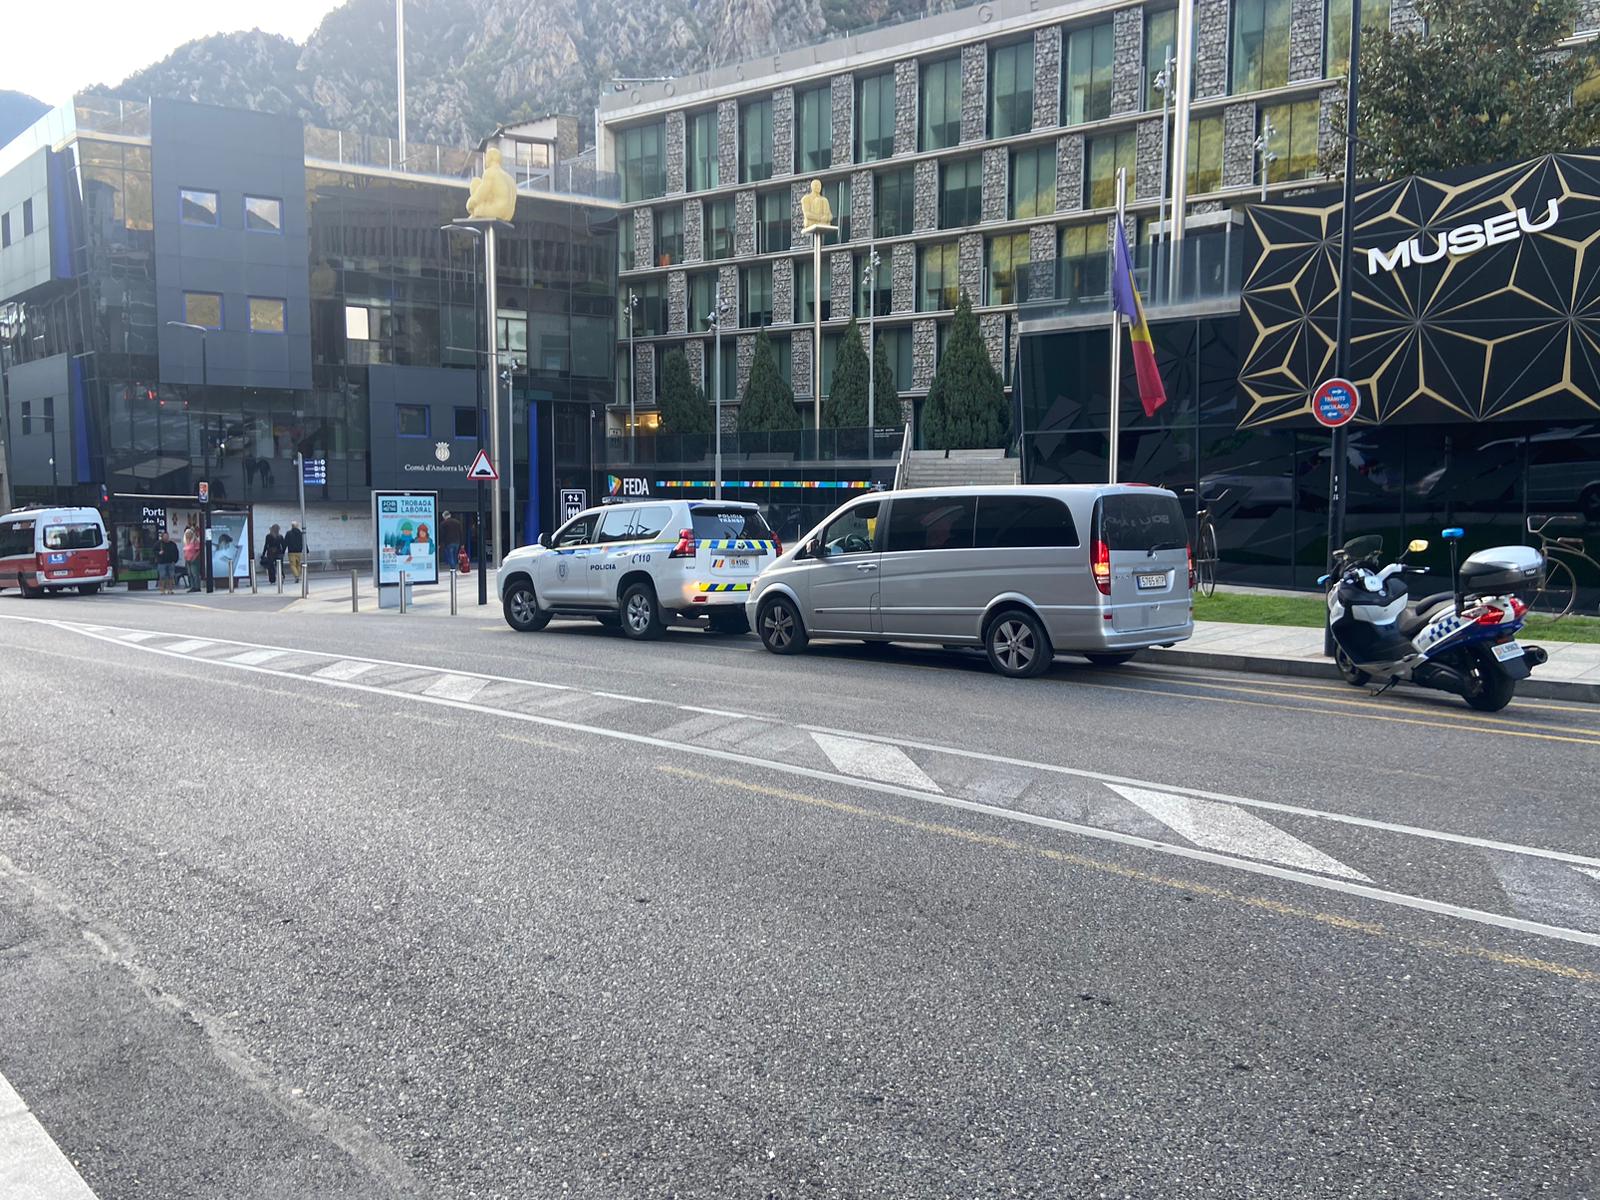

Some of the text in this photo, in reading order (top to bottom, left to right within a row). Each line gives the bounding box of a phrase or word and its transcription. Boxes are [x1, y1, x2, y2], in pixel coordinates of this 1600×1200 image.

[1367, 197, 1560, 275] MUSEU
[425, 463, 457, 472] d'Andorra
[623, 478, 649, 496] FEDA
[638, 553, 651, 563] 110
[590, 563, 616, 571] POLICIA
